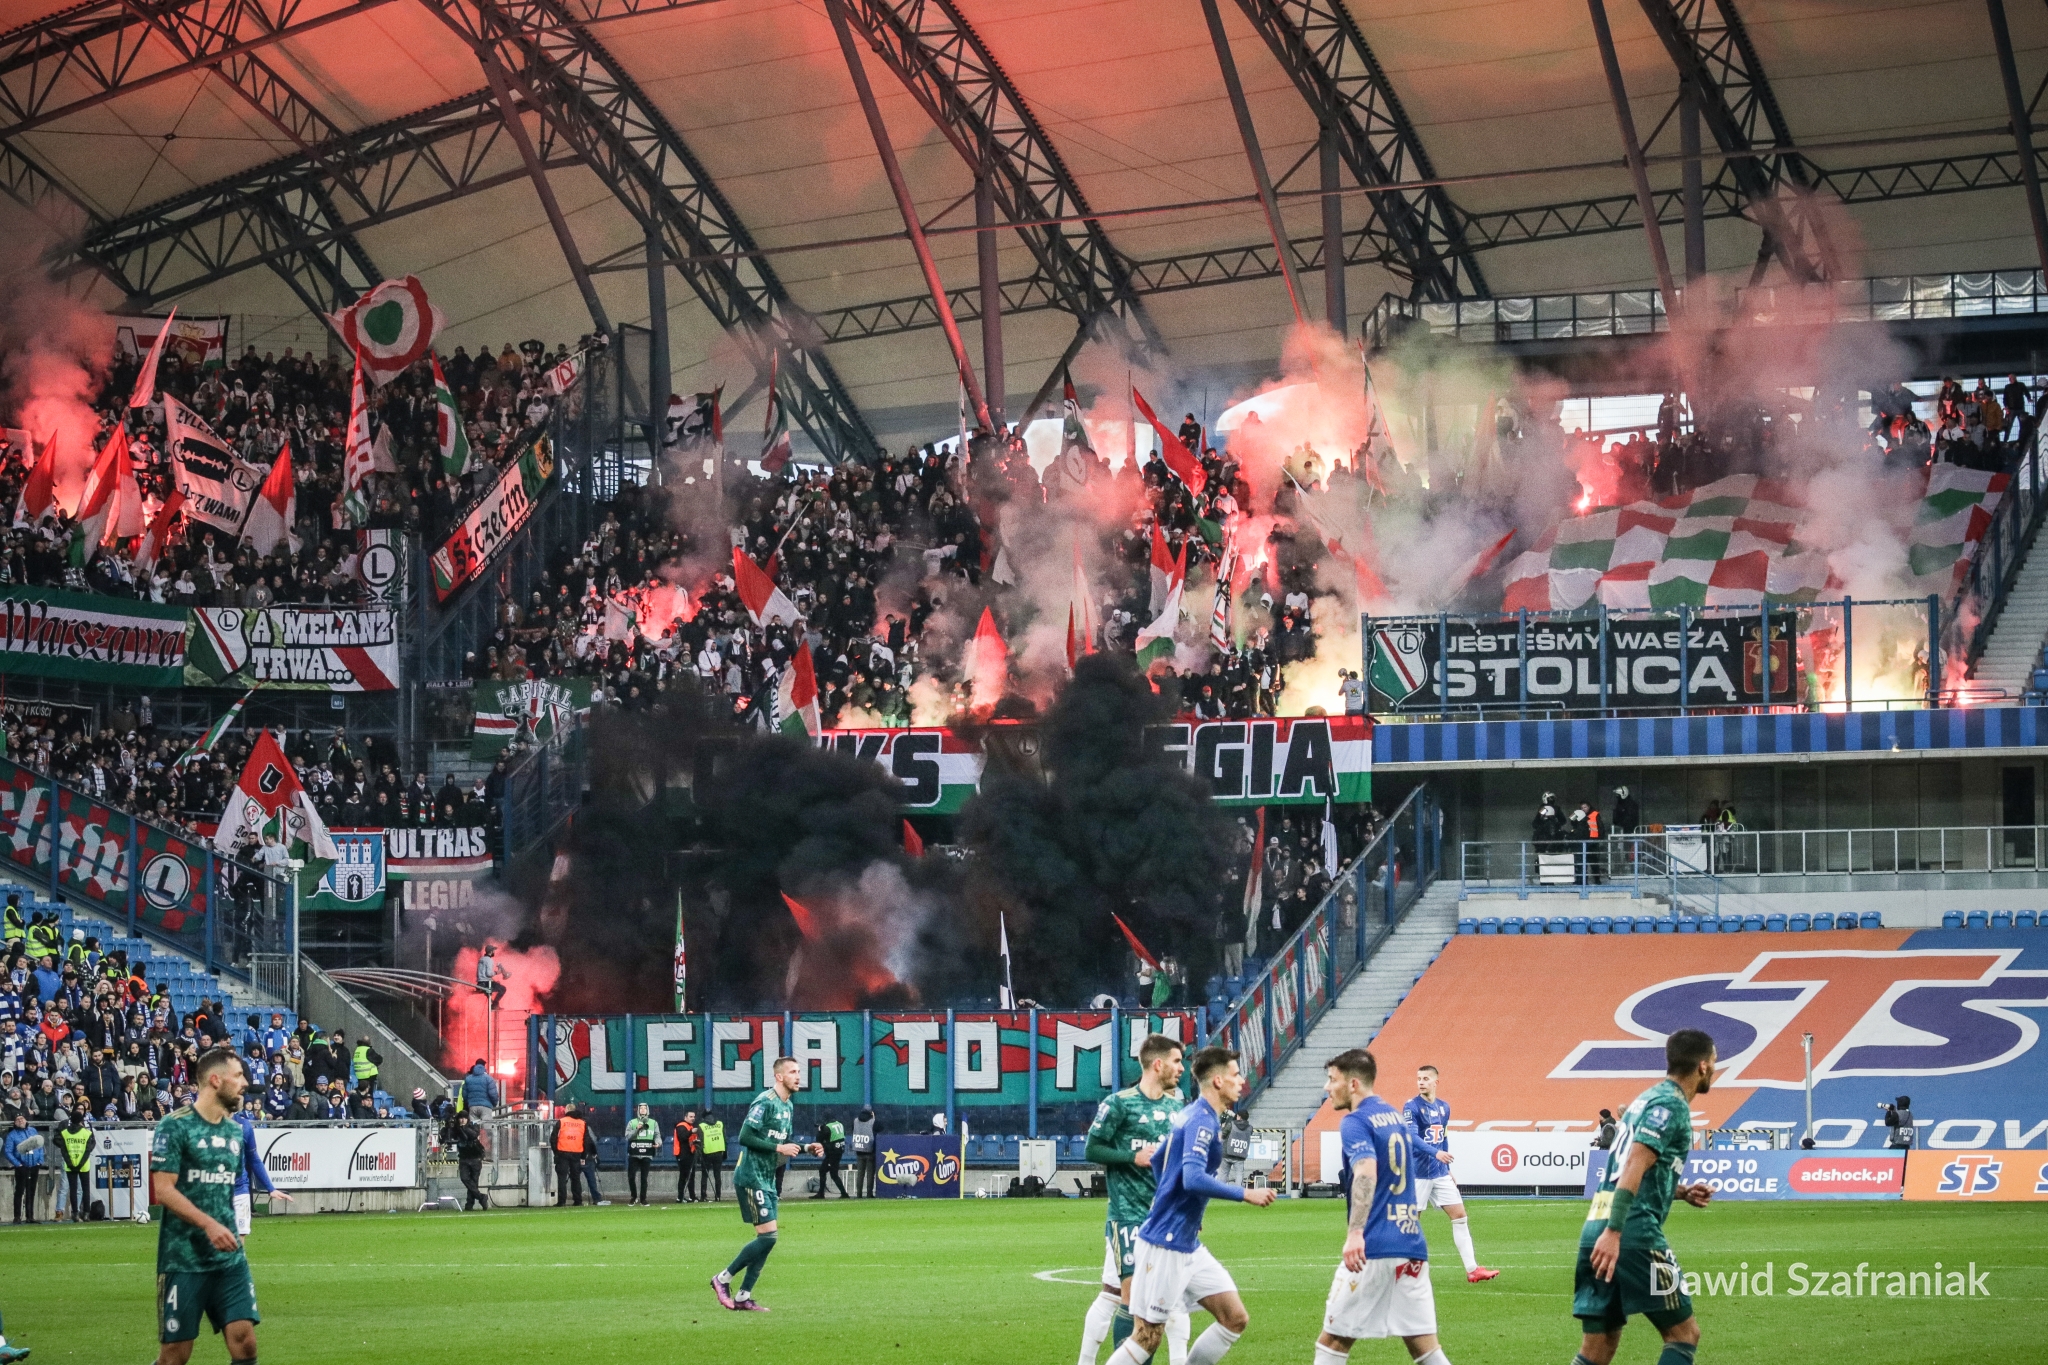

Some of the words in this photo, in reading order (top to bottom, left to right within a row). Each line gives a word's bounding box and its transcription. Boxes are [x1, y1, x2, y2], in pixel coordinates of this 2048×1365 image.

[204, 497, 241, 523] WAMI
[470, 557, 491, 582] LUDZIE
[492, 532, 513, 560] WIERNI
[0, 598, 181, 668] Warszawa
[250, 611, 273, 646] A
[1446, 628, 1600, 653] JESTEŚMY
[1614, 630, 1730, 653] WASZĄ
[1432, 656, 1737, 701] STOLICĄ
[496, 681, 573, 710] CAPITAL
[390, 827, 486, 858] ULTRAS
[155, 864, 176, 900] L
[403, 880, 474, 910] LEGIA
[1547, 949, 2048, 1090] STS
[590, 1019, 838, 1093] LEGIA
[893, 1020, 999, 1091] TO
[852, 1134, 870, 1144] FOTO
[1230, 1138, 1248, 1150] FOTO
[1424, 1124, 1445, 1144] STS
[1899, 1127, 1913, 1137] FOTO
[356, 1151, 396, 1171] InterHall
[1258, 1144, 1267, 1155] 8
[1523, 1151, 1585, 1169] rodo.pl
[268, 1152, 311, 1172] InterHall
[888, 1161, 920, 1178] LOTTO
[938, 1161, 956, 1179] LOTTO
[1690, 1159, 1732, 1174] TOP
[1737, 1159, 1758, 1174] 10
[1801, 1168, 1893, 1184] adshock.pl
[1936, 1155, 2003, 1196] STS
[755, 1190, 765, 1205] 9
[1120, 1225, 1139, 1248] 14
[166, 1284, 178, 1311] 4
